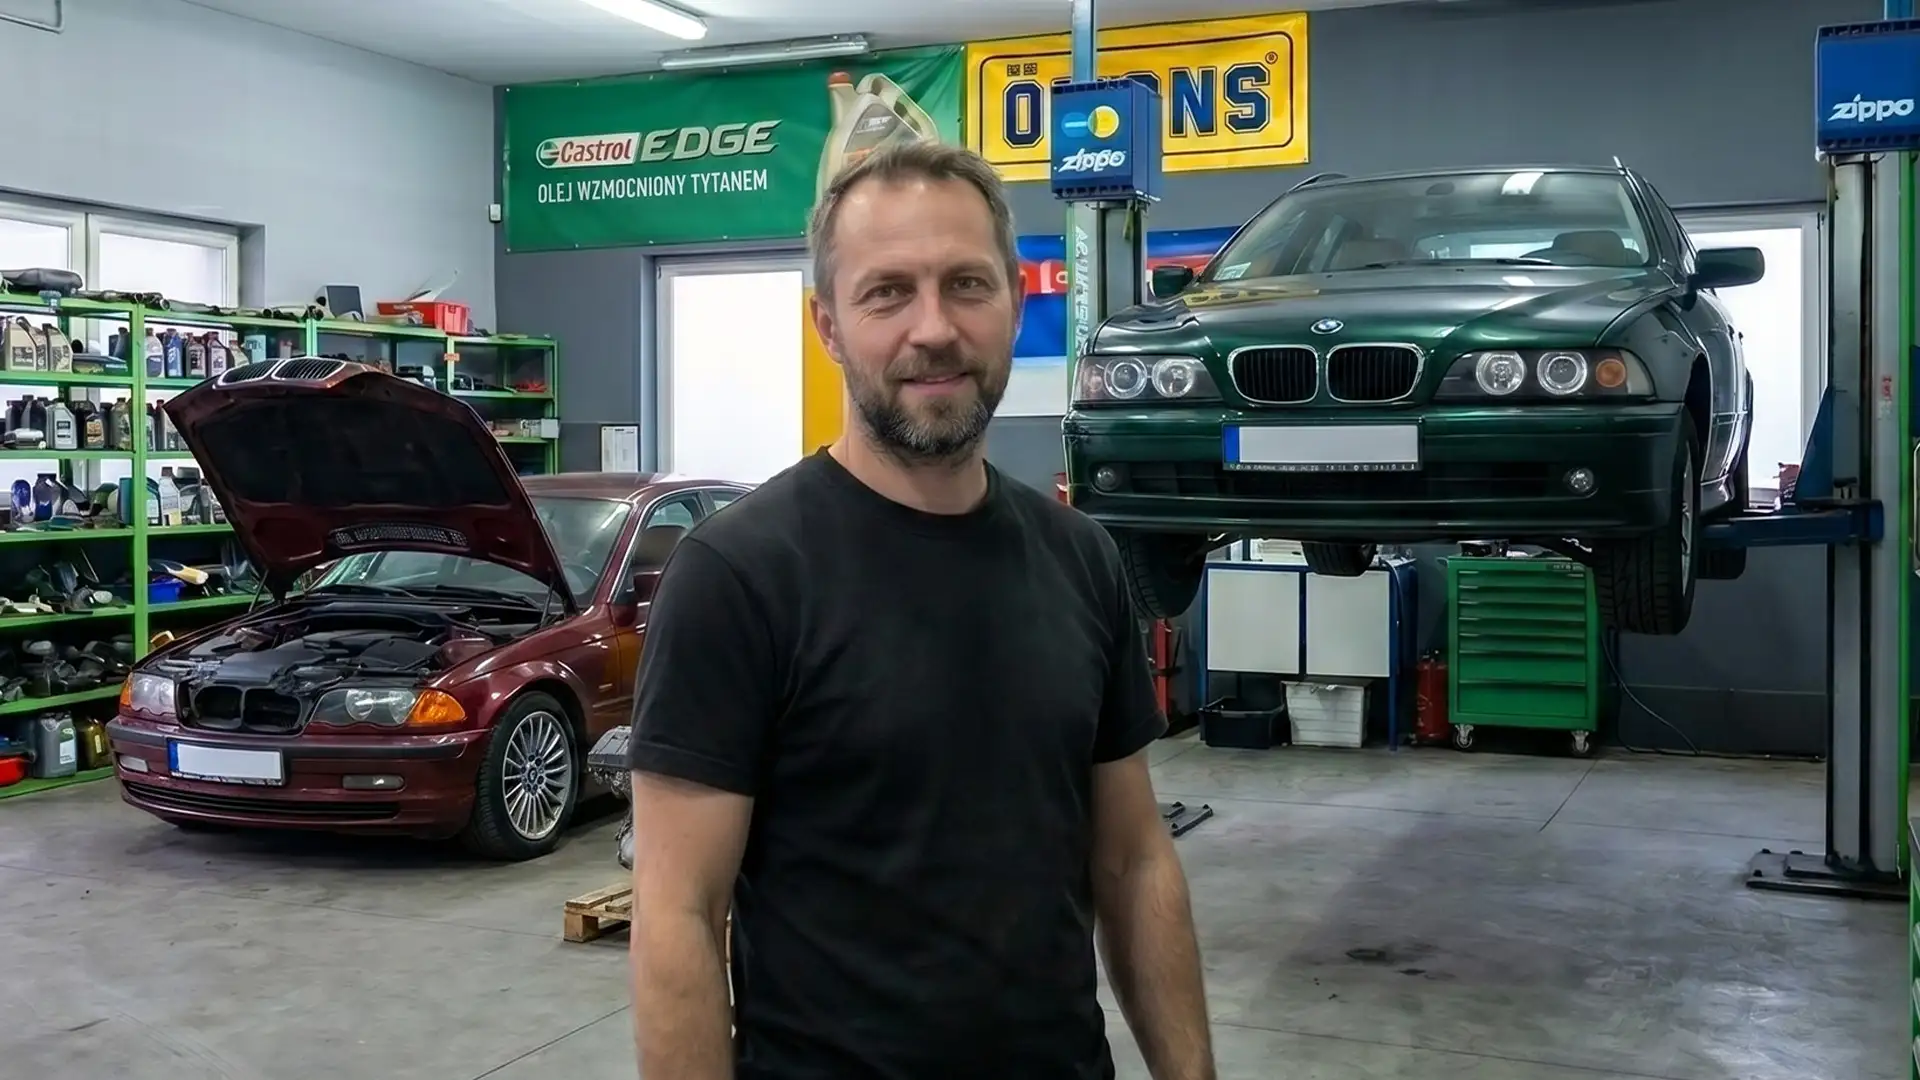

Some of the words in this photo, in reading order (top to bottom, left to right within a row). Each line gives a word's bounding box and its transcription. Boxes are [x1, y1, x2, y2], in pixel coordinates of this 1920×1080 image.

[1827, 93, 1915, 123] zippo
[560, 138, 632, 164] Castrol
[640, 119, 783, 162] EDGE
[1058, 147, 1126, 173] zippo
[537, 182, 573, 204] OLEJ
[577, 174, 686, 201] WZMOCNIONY
[691, 168, 768, 194] TYTANEM
